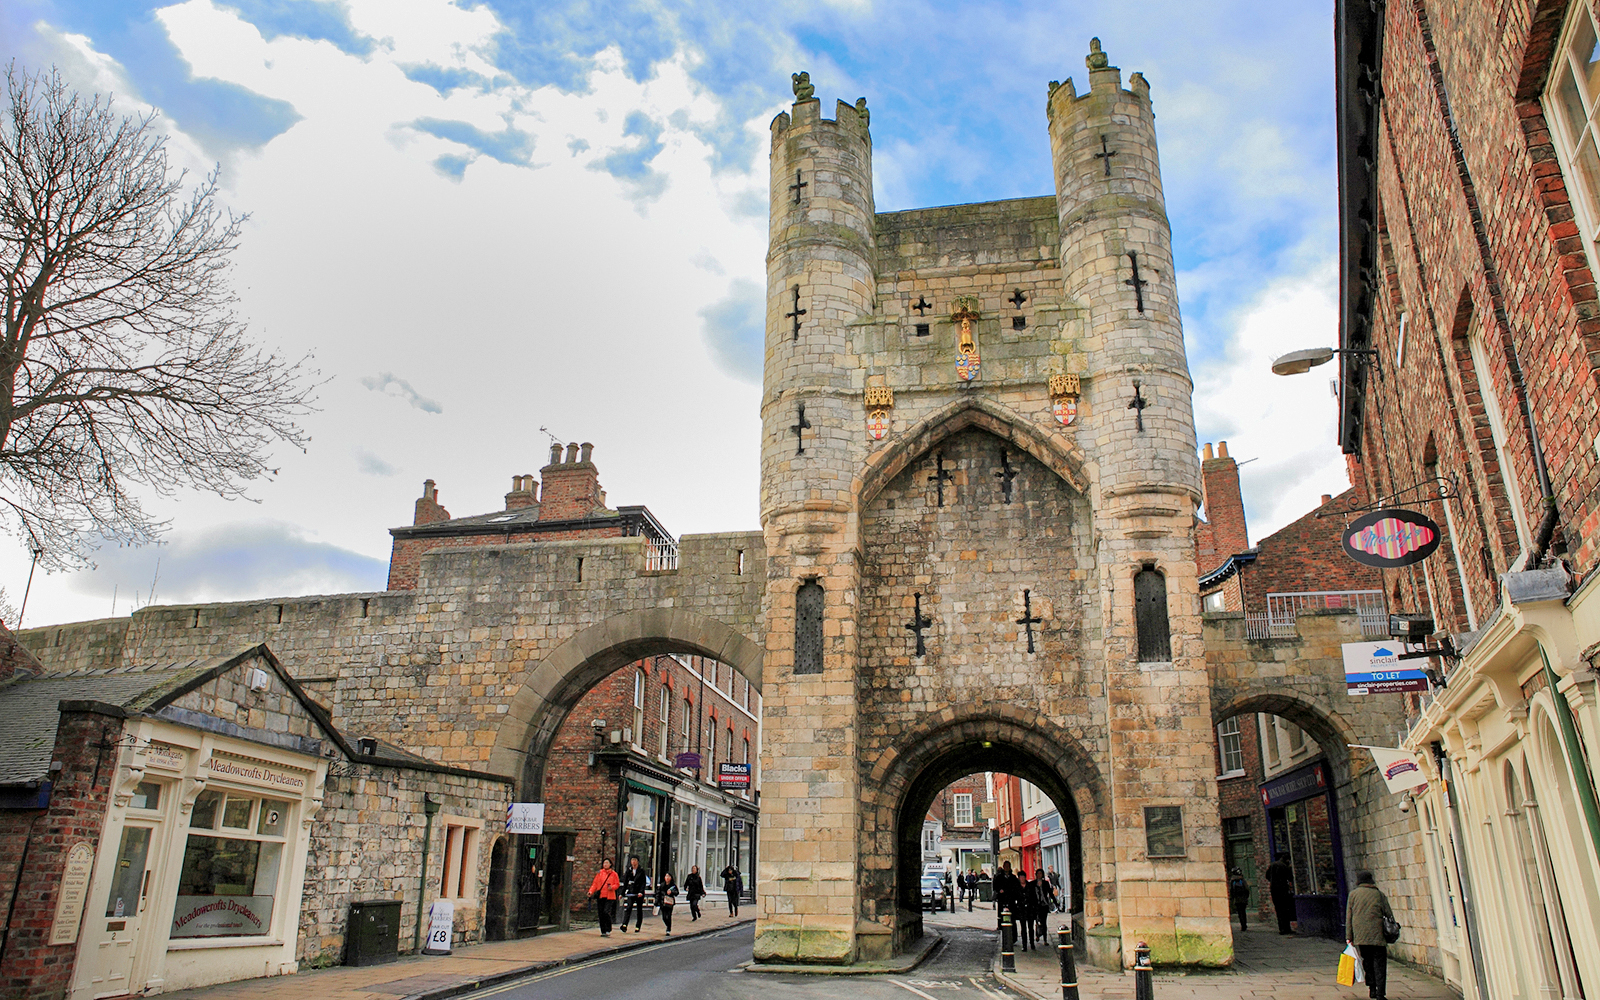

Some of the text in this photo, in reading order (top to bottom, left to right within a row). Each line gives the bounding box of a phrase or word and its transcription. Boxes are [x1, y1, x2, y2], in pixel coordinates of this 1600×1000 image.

[1361, 526, 1422, 549] Monty's
[1369, 656, 1398, 665] sinclair
[1371, 671, 1401, 680] TO LET
[1357, 680, 1418, 689] sinclair-properties.com
[210, 758, 304, 788] Meadowcrofts Drycleaners
[721, 764, 748, 773] Blacks
[509, 822, 541, 830] BARBERS
[175, 898, 262, 931] Meadowcrofts Drycleaners
[111, 932, 117, 940] 2
[432, 930, 447, 942] £8
